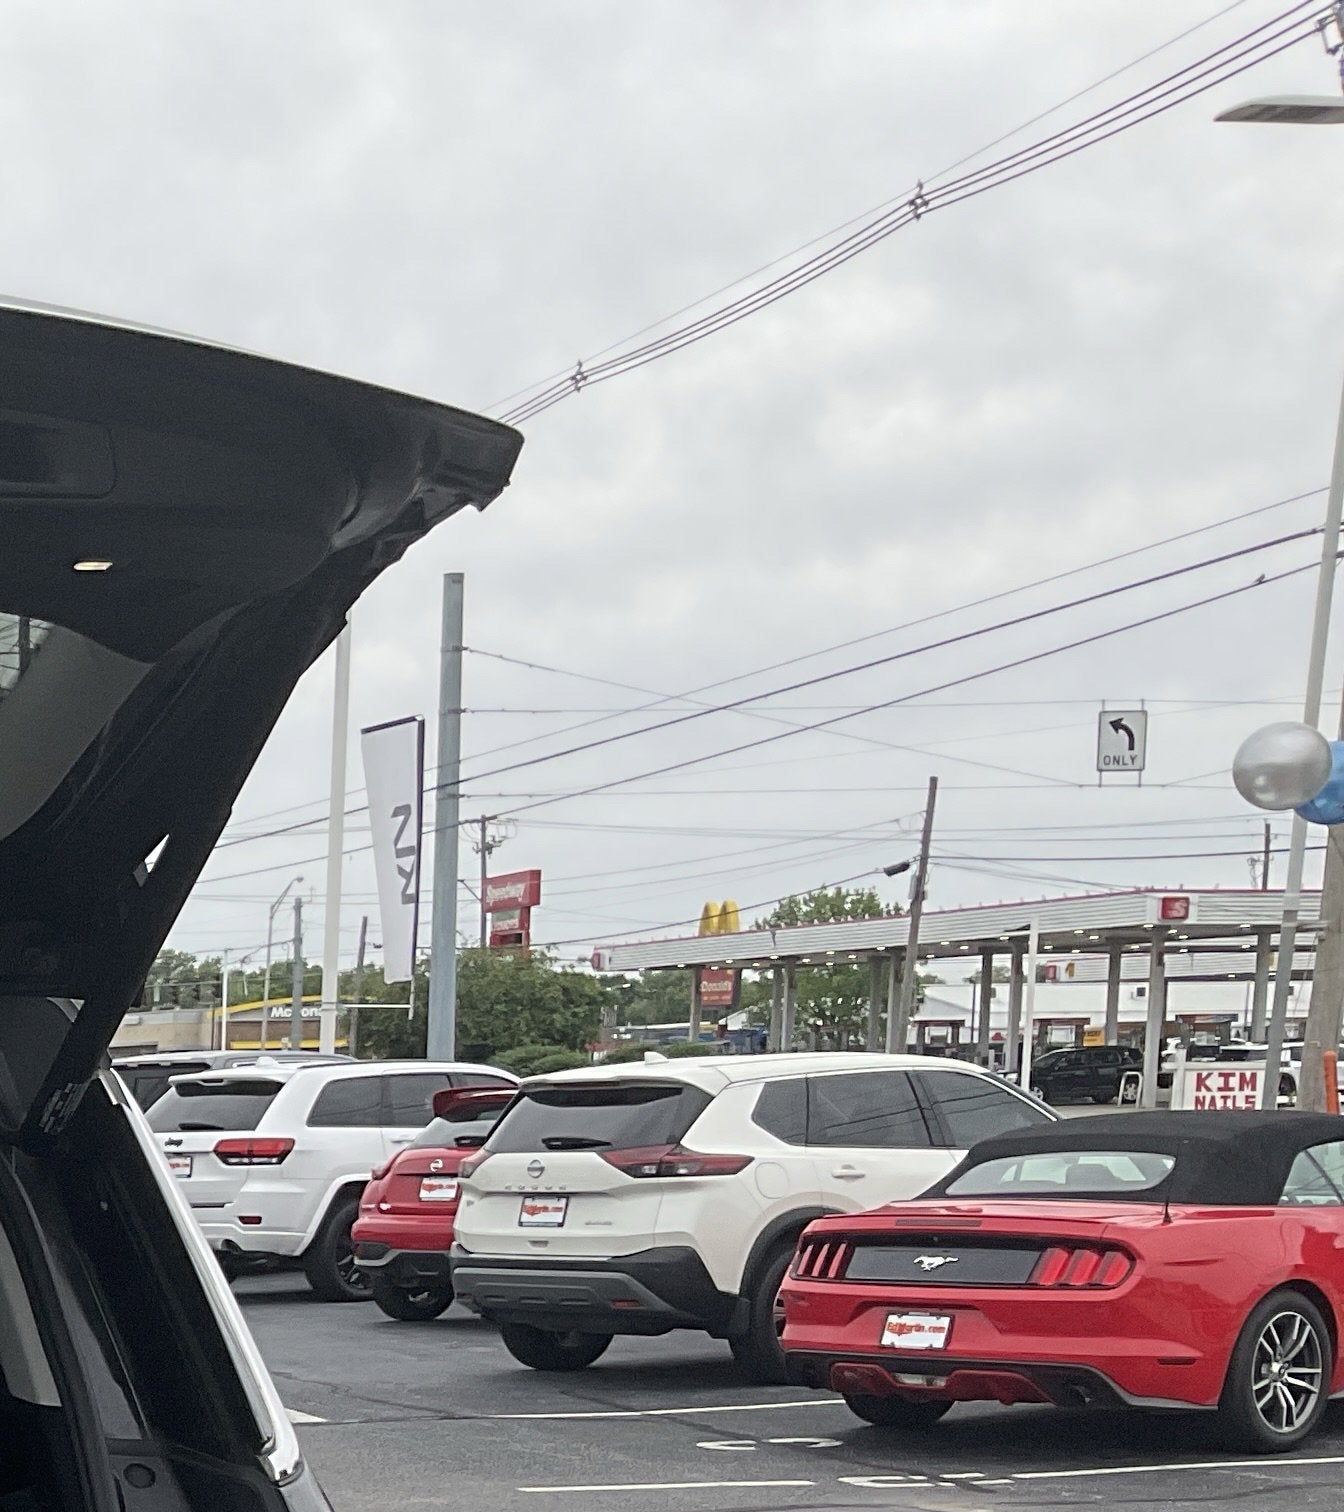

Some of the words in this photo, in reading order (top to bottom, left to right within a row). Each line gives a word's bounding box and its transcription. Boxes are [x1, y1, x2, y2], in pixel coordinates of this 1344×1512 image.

[1102, 754, 1139, 767] ONLY
[1195, 1071, 1258, 1092] KIM
[1194, 1095, 1256, 1111] NAILS
